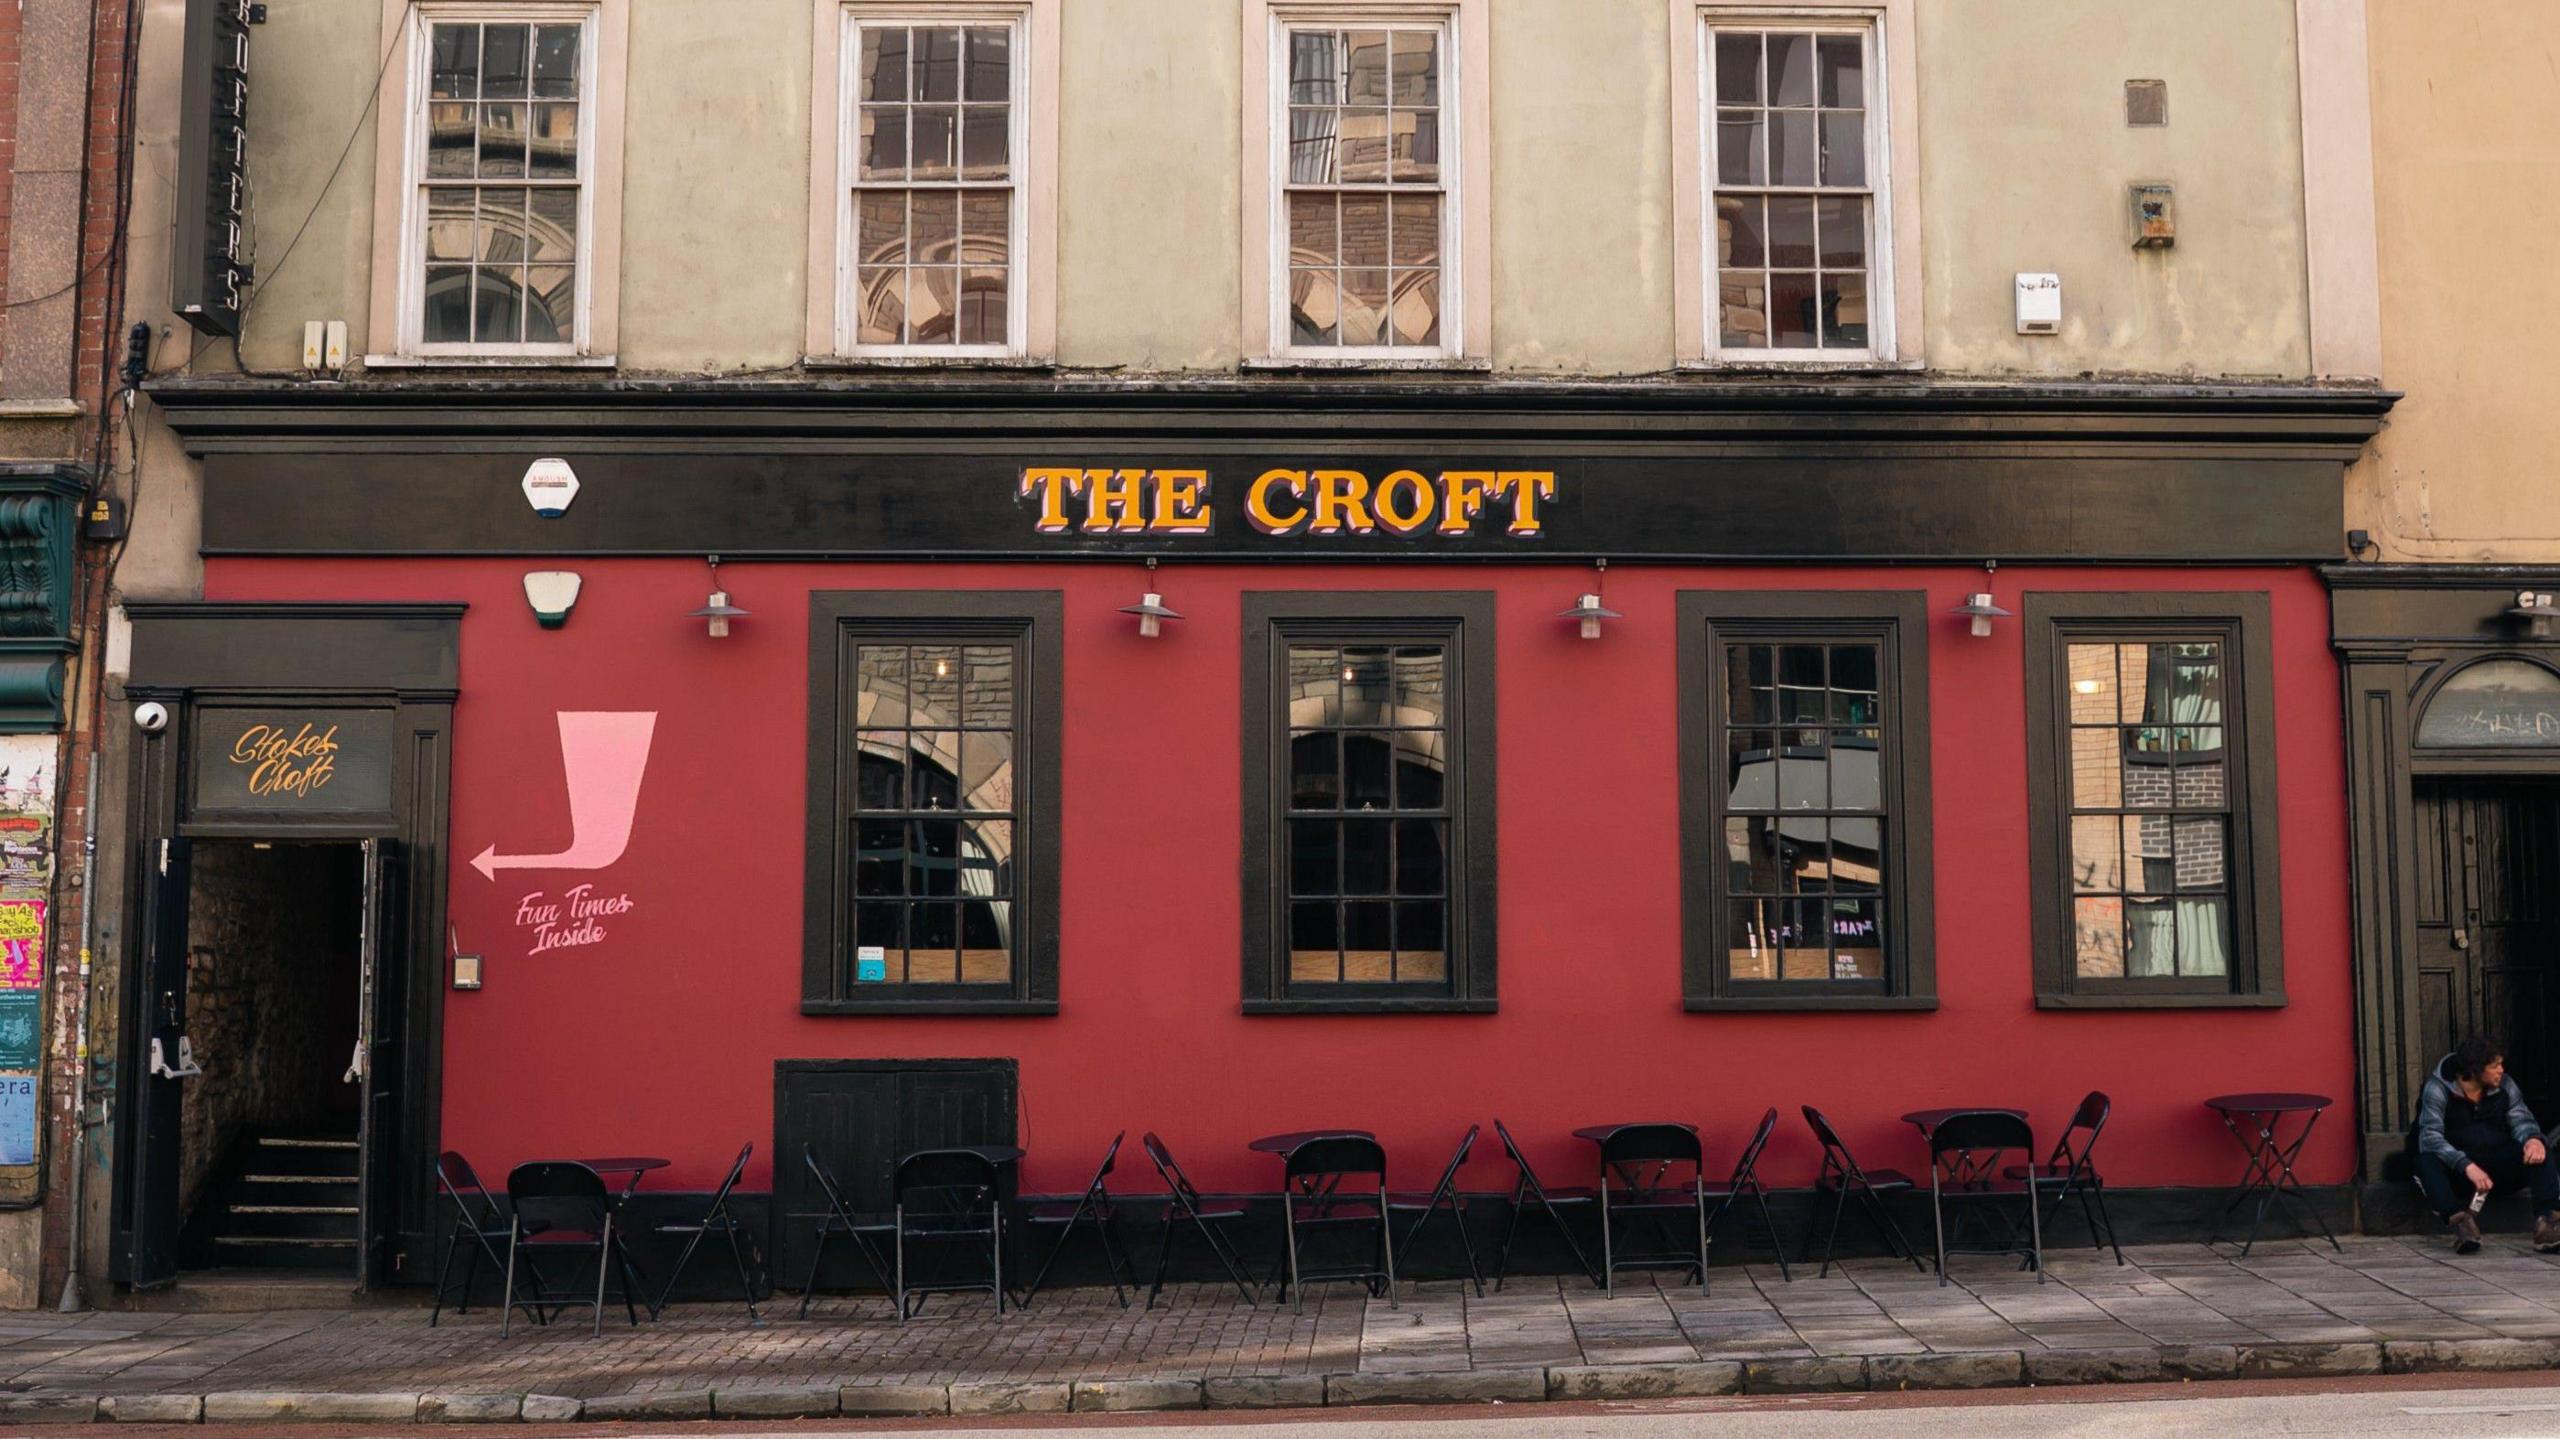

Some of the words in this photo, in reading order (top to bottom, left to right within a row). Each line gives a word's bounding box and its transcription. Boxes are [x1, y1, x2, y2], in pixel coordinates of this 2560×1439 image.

[1020, 467, 1216, 536] THE
[1243, 468, 1560, 538] CROFT
[229, 722, 338, 763] Stokes
[249, 755, 335, 798] Croft
[515, 890, 563, 926] Fun
[564, 883, 634, 919] Times
[528, 917, 607, 956] Inside
